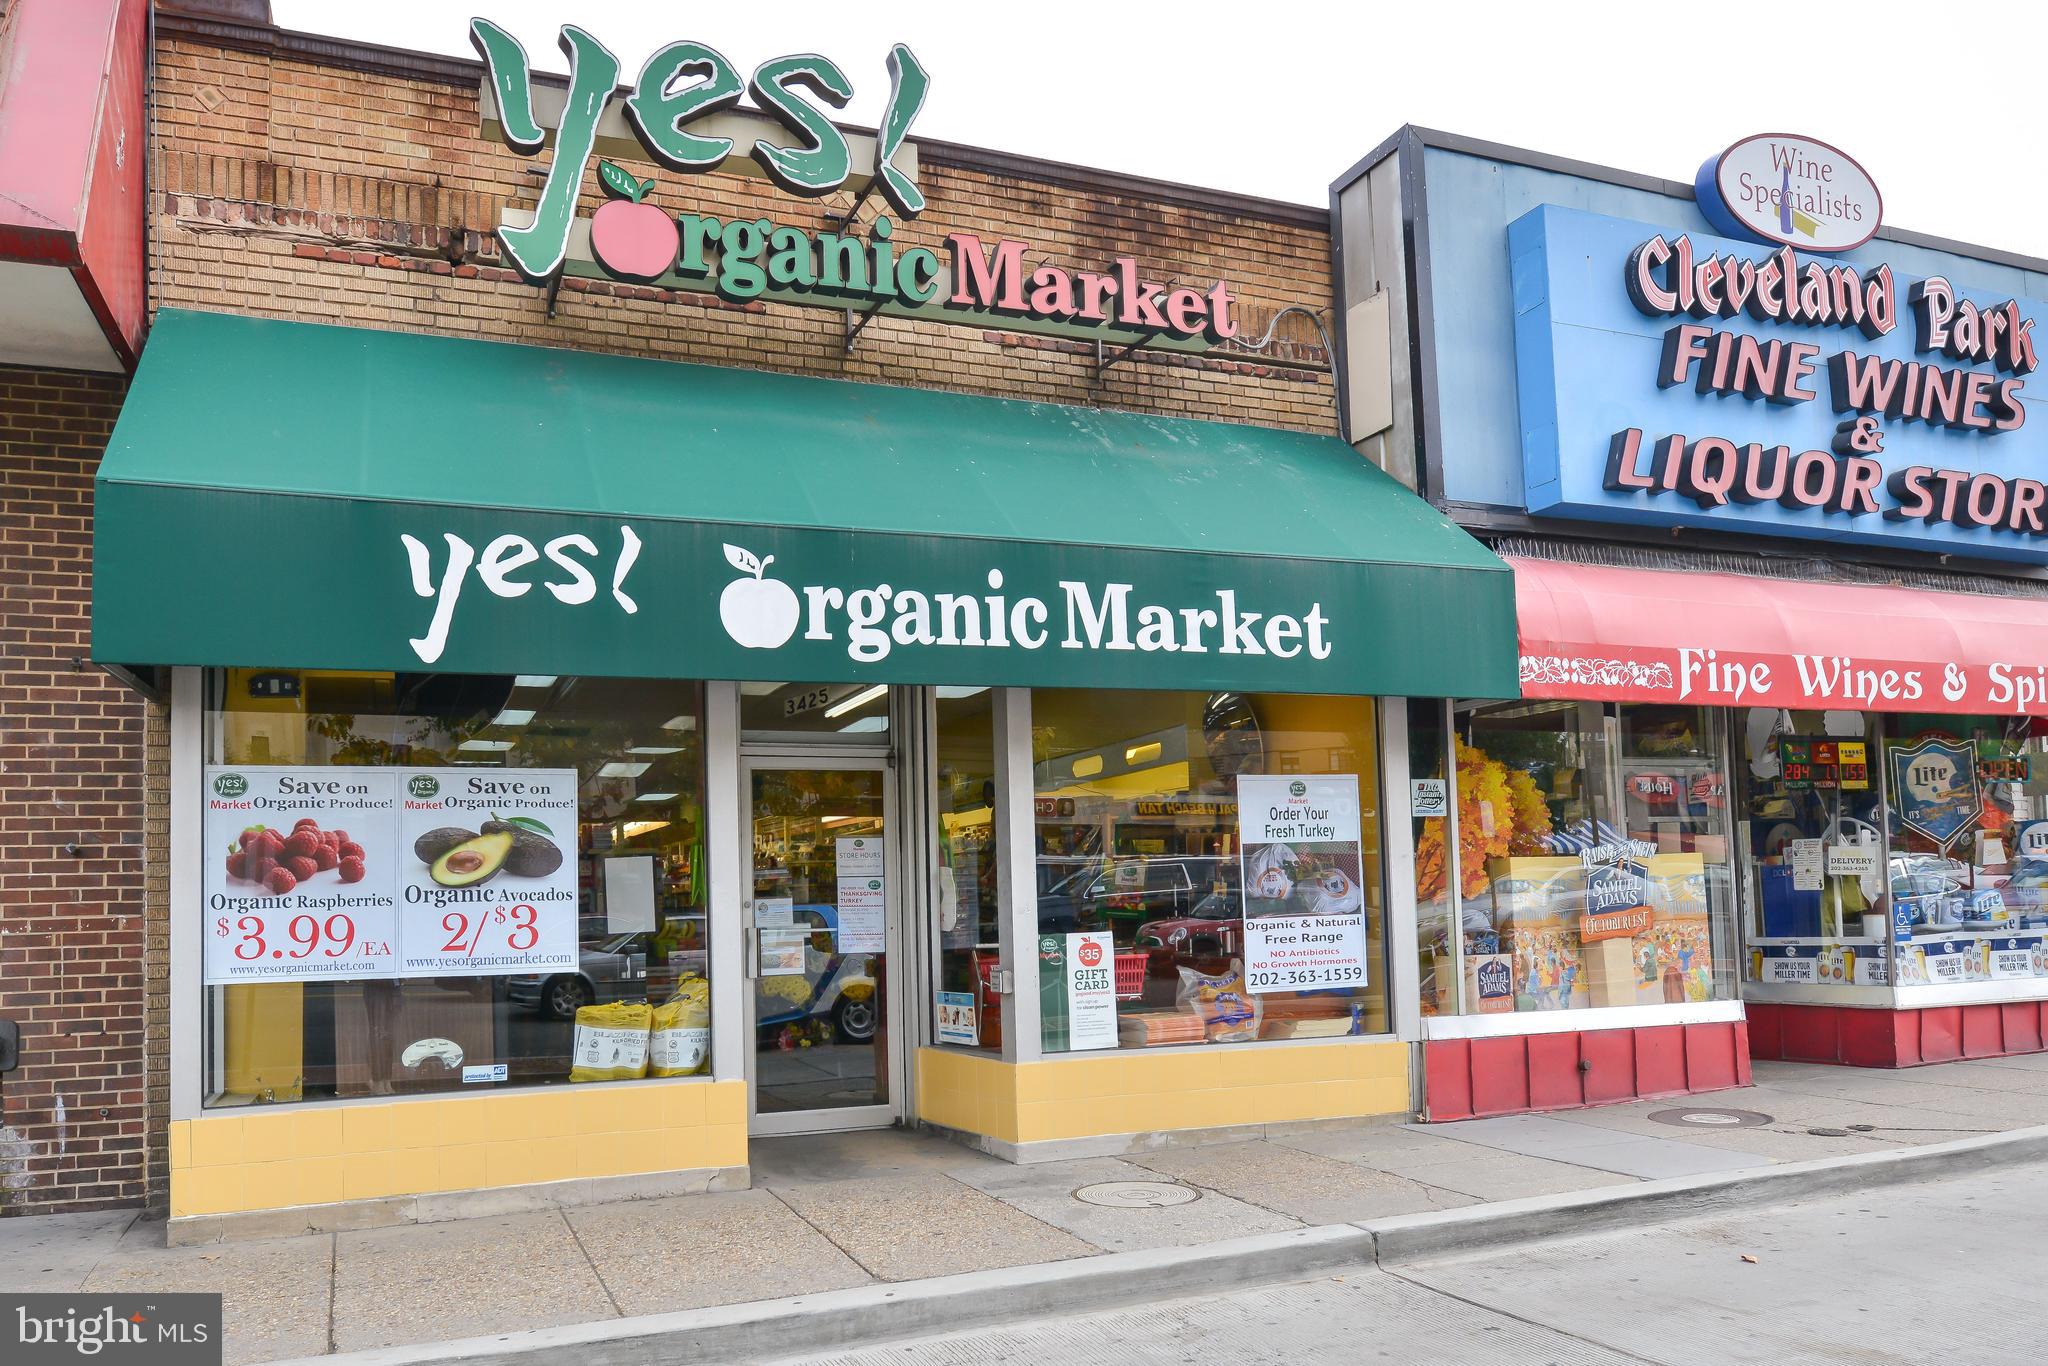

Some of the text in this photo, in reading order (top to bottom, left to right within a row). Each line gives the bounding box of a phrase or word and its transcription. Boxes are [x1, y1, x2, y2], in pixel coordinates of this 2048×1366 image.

[1769, 143, 1833, 183] Wine
[1739, 172, 1863, 222] Specialists
[946, 231, 1239, 339] Market
[1629, 233, 2040, 374] Cleveland Park
[1670, 323, 2027, 432] FINE WINES
[1846, 415, 1885, 454] &
[1612, 427, 1883, 514] LIQUOR
[1058, 580, 1332, 660] Market
[1676, 647, 1773, 704] Fine
[1791, 653, 1924, 710] Wines
[1942, 662, 1968, 703] &
[786, 688, 829, 715] 3425
[1784, 764, 1811, 780] 284
[1913, 766, 1948, 787] Lite
[1980, 758, 2028, 780] OPEN
[278, 776, 369, 795] Save on
[467, 777, 551, 795] Save on
[210, 800, 251, 810] Market
[253, 796, 393, 811] Organic Produce!
[404, 800, 443, 810] Market
[444, 796, 574, 811] Organic Produce!
[1270, 806, 1329, 820] Order Your
[1265, 824, 1335, 840] Fresh Turkey
[861, 851, 881, 859] HOURS
[1830, 857, 1873, 865] DELIVERY
[1593, 876, 1642, 897] SAMUEL
[210, 893, 393, 914] Organic Raspberries
[404, 884, 573, 909] Organic Avocados
[1595, 890, 1638, 911] ADAMS
[1246, 917, 1361, 932] Organic & Natural
[1265, 933, 1343, 945] Free Range
[406, 952, 572, 969] www.yesorganicmarket.com
[1079, 948, 1100, 960] $35
[1270, 948, 1340, 958] NO Antibiotics
[1998, 953, 2028, 963] SHOW US YOUR
[230, 961, 375, 975] www.yesorganicmarket.com
[1252, 957, 1358, 969] NO Growth Hormones
[1774, 961, 1811, 970] SHOW US YOUR
[1935, 959, 1949, 968] SHOW
[1999, 962, 2028, 971] MILLER TIME
[1074, 968, 1108, 981] GIFT
[1250, 967, 1362, 986] 202-363-1559
[1480, 972, 1509, 985] SAMUEL
[1774, 970, 1811, 979] MILLER TIME
[1936, 966, 1956, 976] MILLER
[1075, 980, 1109, 991] CARD
[1483, 982, 1507, 995] ADAMS
